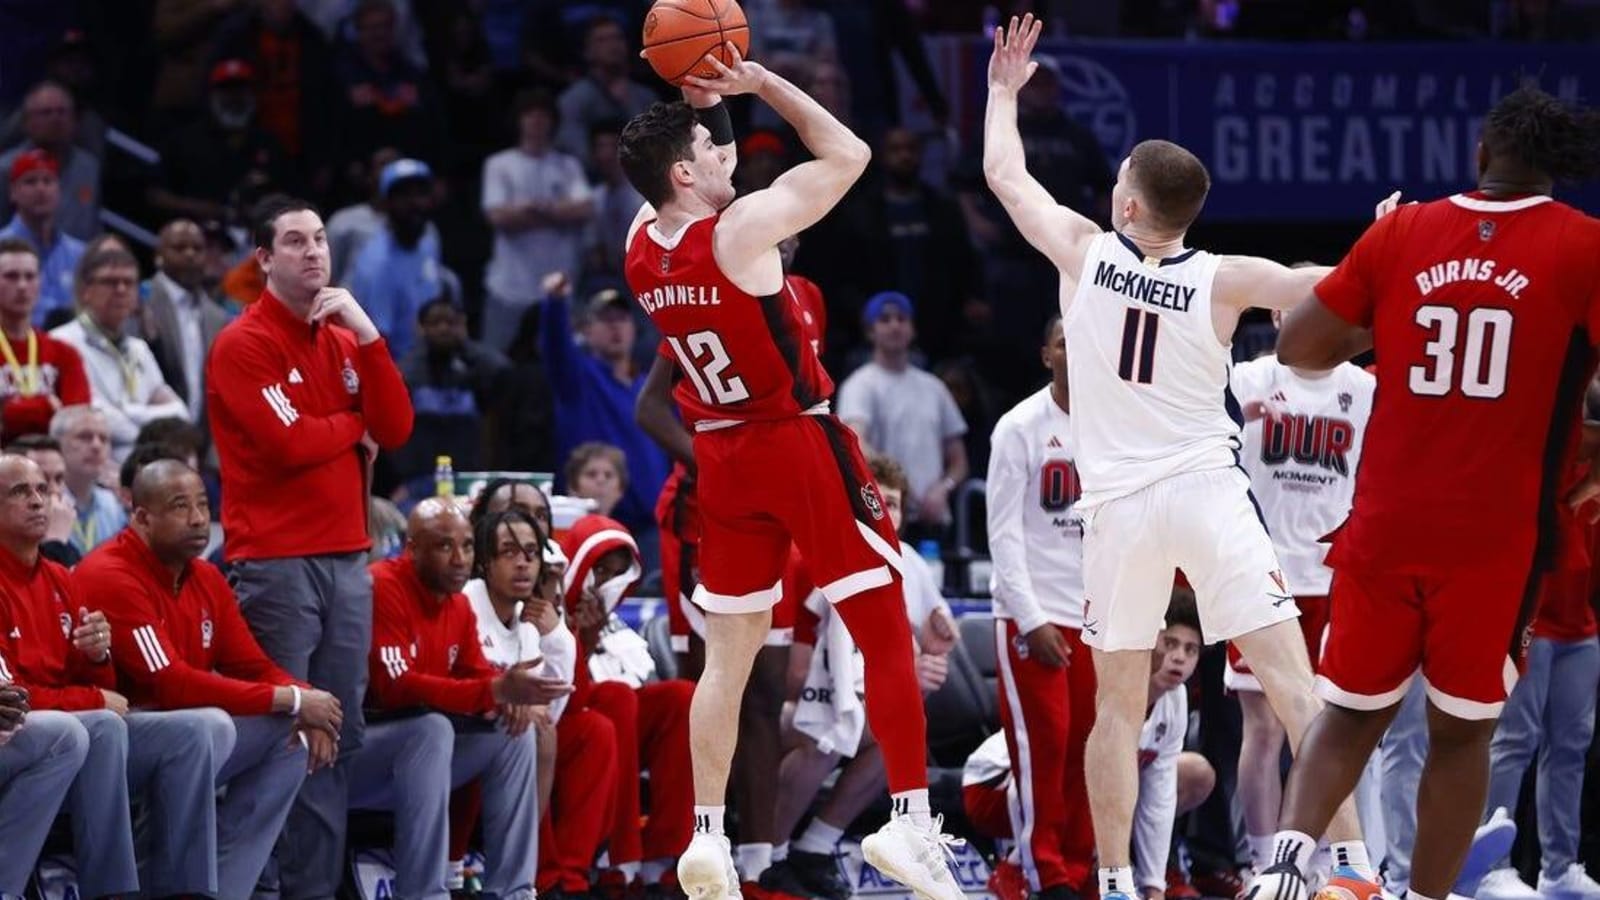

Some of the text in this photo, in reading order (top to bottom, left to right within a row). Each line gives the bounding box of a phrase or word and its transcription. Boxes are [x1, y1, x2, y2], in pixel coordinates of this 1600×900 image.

[1215, 75, 1579, 109] ACCOMPLIH
[1093, 261, 1196, 312] McKNEELY
[1415, 258, 1530, 300] BURNS JR.
[667, 330, 750, 405] 12
[1118, 307, 1159, 384] 11
[1408, 305, 1514, 399] 30
[1261, 412, 1355, 479] OUR
[1272, 470, 1338, 485] MOMENT
